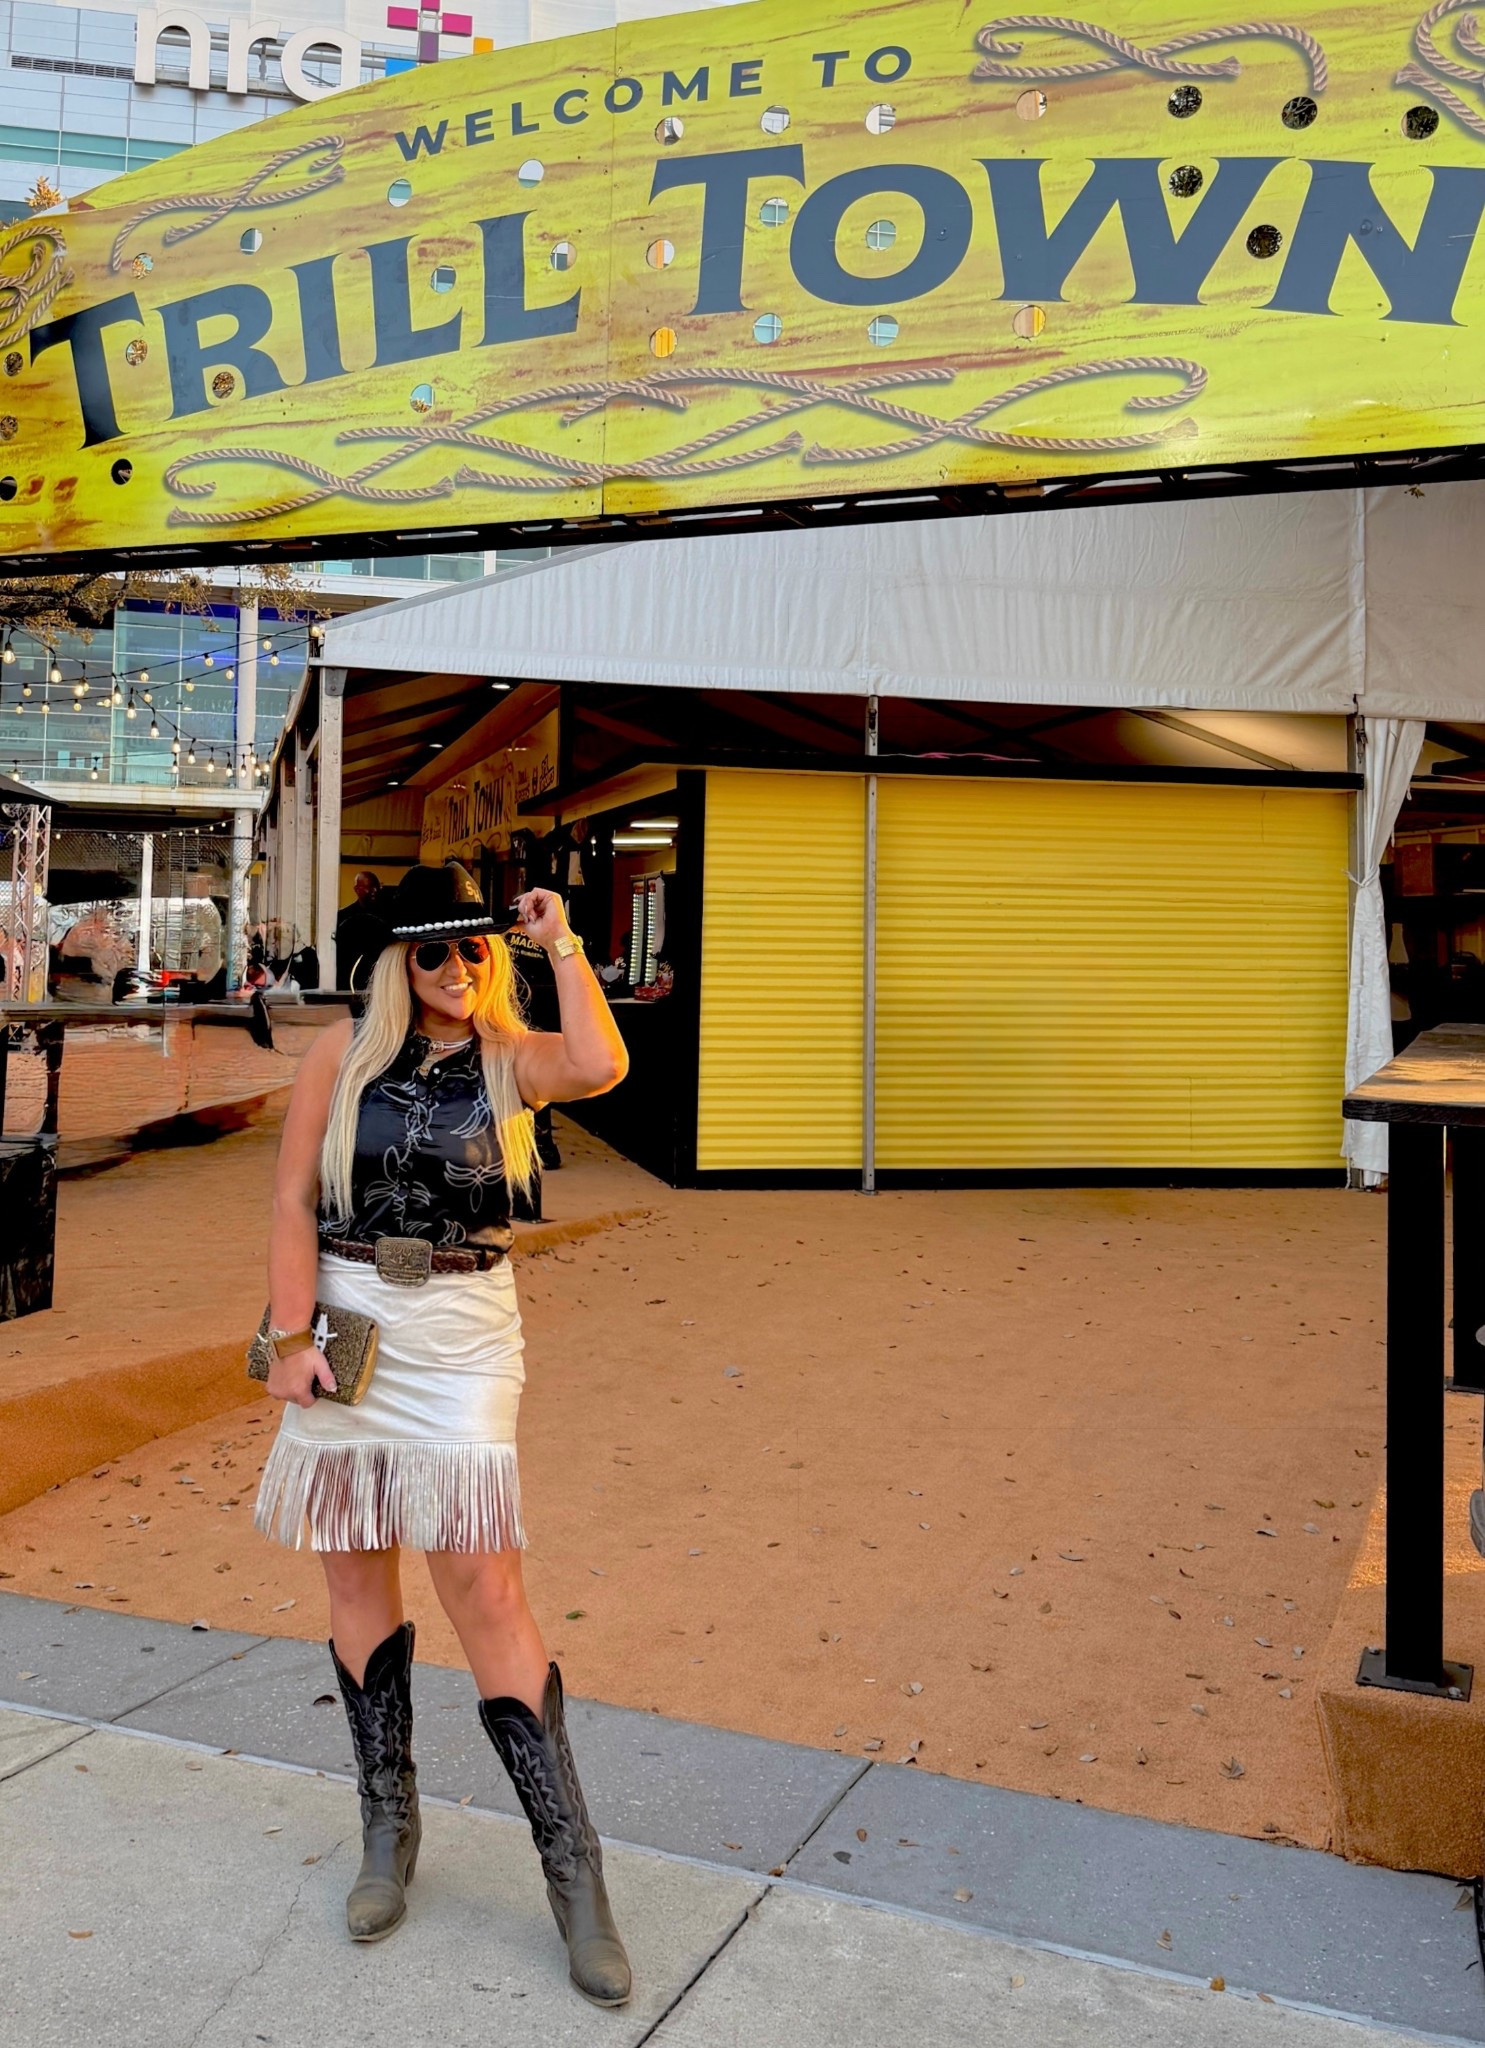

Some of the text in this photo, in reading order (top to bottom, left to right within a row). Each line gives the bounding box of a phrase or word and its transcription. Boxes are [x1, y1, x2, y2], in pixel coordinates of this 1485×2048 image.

[394, 45, 912, 162] WELCOME TO
[29, 143, 1485, 451] TRILL TOWN
[448, 795, 470, 845] TRILL
[474, 775, 505, 837] TOWN
